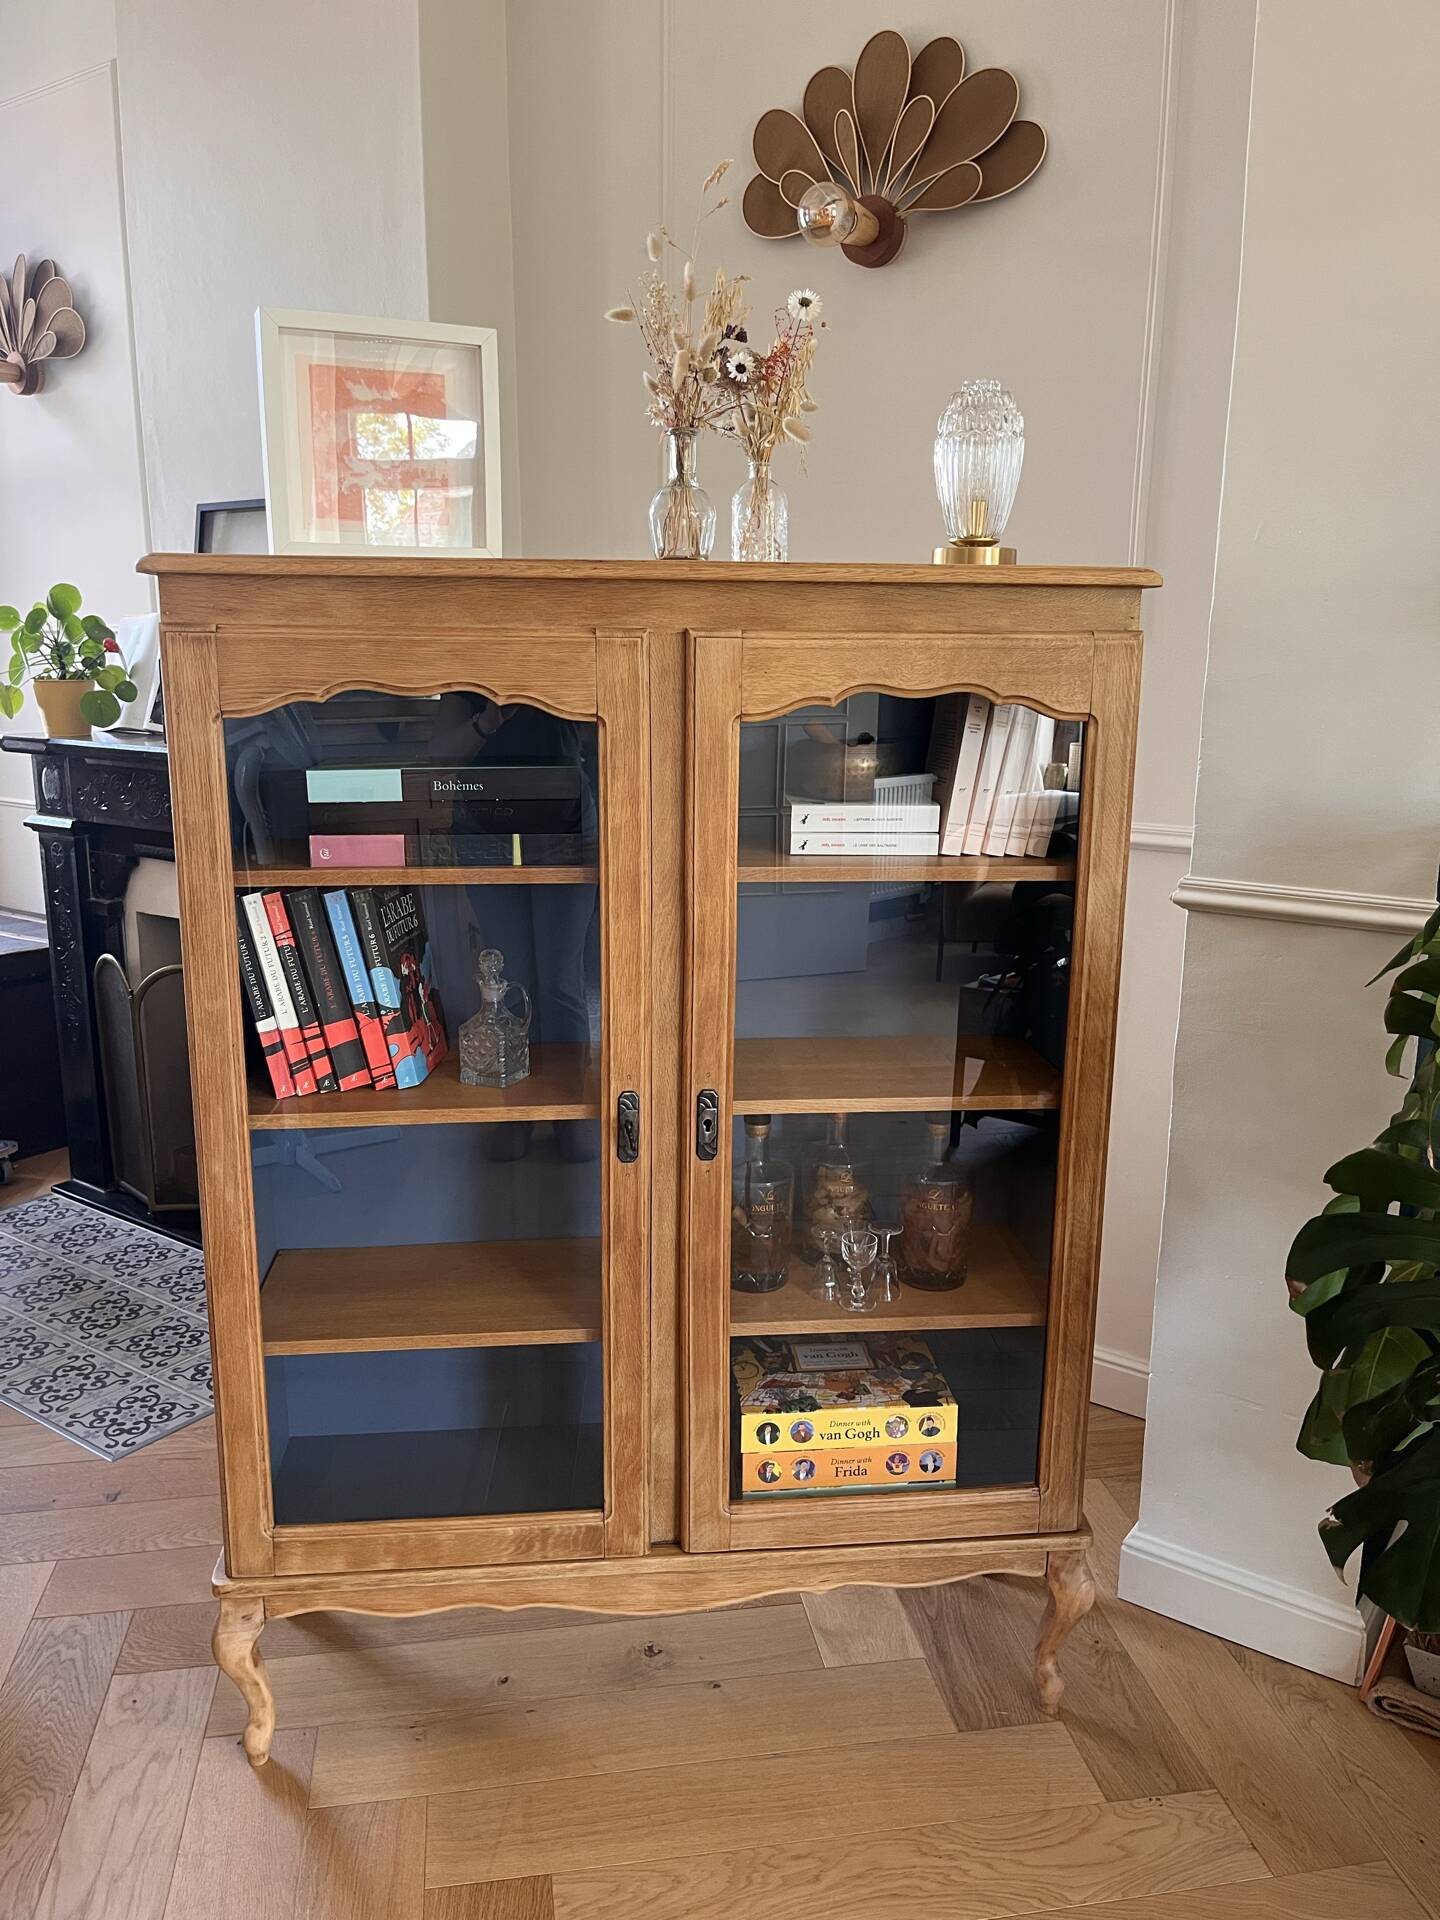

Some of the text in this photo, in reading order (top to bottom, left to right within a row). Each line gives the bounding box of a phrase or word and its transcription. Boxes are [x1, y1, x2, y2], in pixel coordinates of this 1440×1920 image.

[433, 779, 484, 791] Bohèmes
[380, 893, 415, 928] L'ARABE
[386, 928, 395, 944] DU
[393, 917, 414, 939] FUTUR
[412, 914, 419, 927] 6
[239, 943, 253, 971] FUTUR
[261, 940, 274, 968] FUTUR
[311, 935, 324, 962] FUTUR
[344, 938, 356, 967] FUTUR
[370, 938, 382, 966] FUTUR
[247, 971, 256, 984] DU
[269, 968, 278, 981] DU
[290, 967, 298, 980] DU
[319, 964, 327, 975] DU
[352, 969, 360, 981] DU
[377, 967, 385, 981] DU
[251, 984, 266, 1017] L'ARABE
[274, 983, 287, 1015] L'ARABE
[293, 980, 308, 1013] L'ARABE
[322, 976, 336, 1008] L'ARABE
[356, 983, 369, 1016] L'ARABE
[819, 1427, 880, 1442] van Gogh
[829, 1420, 854, 1428] Dinner
[830, 1458, 855, 1466] Dinner
[834, 1466, 868, 1478] Frida
